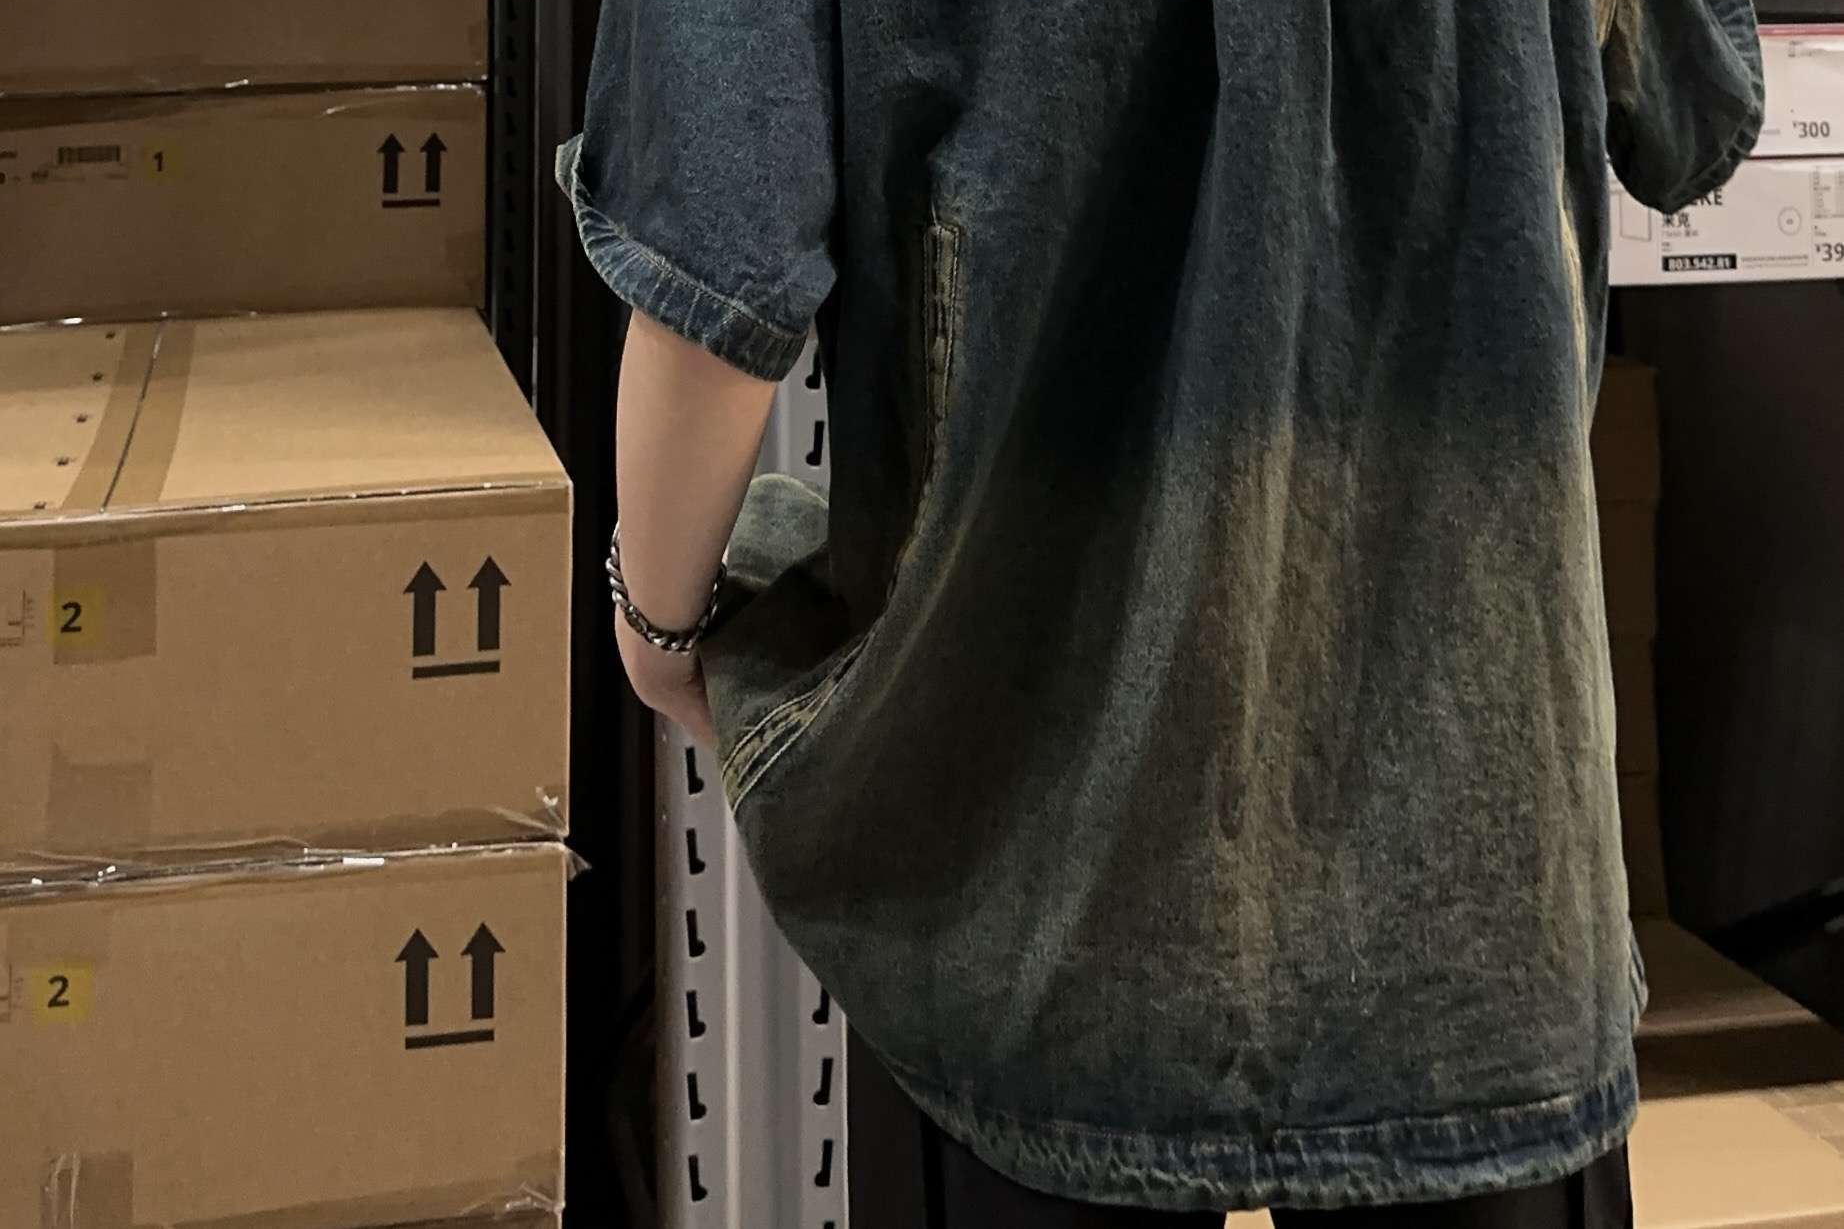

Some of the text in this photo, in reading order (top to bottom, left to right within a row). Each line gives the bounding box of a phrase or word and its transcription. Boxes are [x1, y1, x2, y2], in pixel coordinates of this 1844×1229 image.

[1792, 120, 1831, 139] ¥300
[154, 151, 164, 172] 1
[61, 601, 82, 634] 2
[47, 975, 70, 1008] 2
